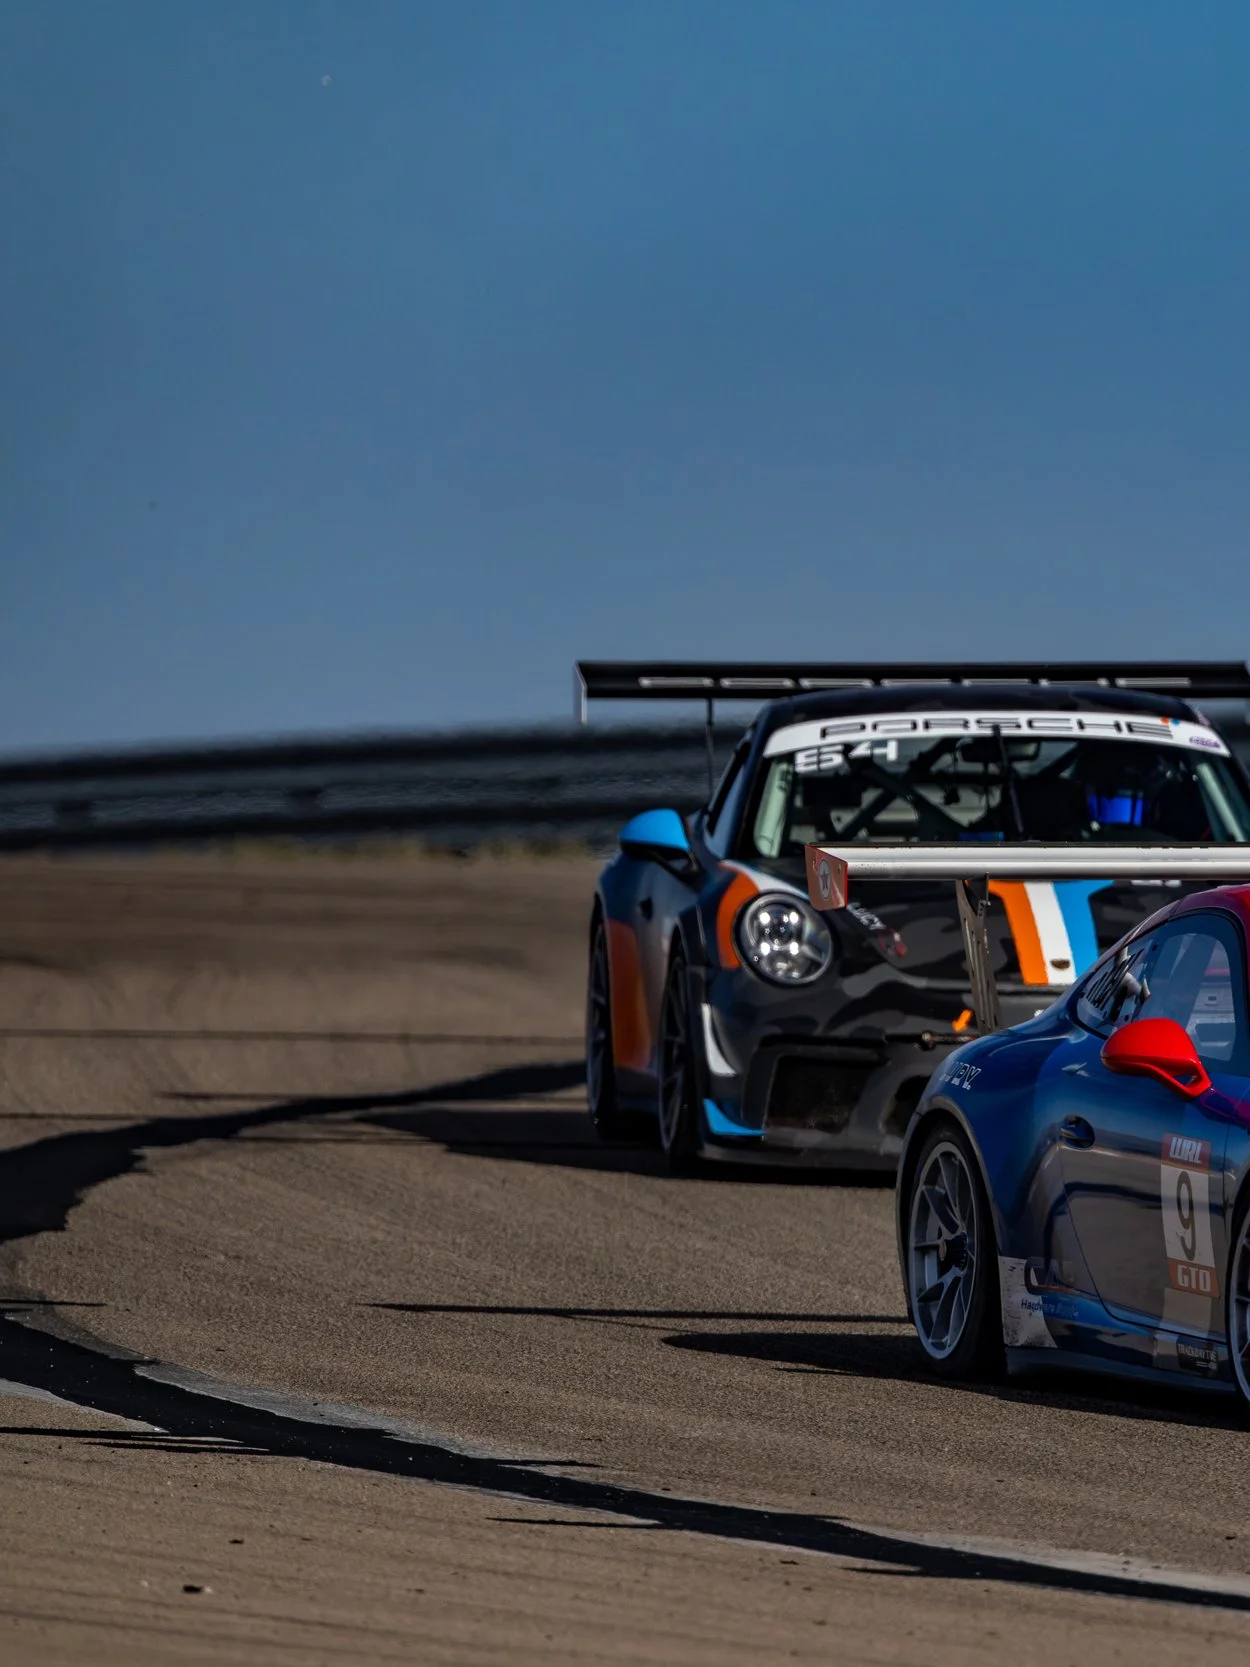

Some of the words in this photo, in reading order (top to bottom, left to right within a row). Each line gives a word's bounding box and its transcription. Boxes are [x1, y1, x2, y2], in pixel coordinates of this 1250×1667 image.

[821, 717, 1173, 739] PORSCHE
[1169, 1136, 1202, 1164] WRL
[1176, 1171, 1196, 1261] 9
[1177, 1264, 1211, 1292] GTO
